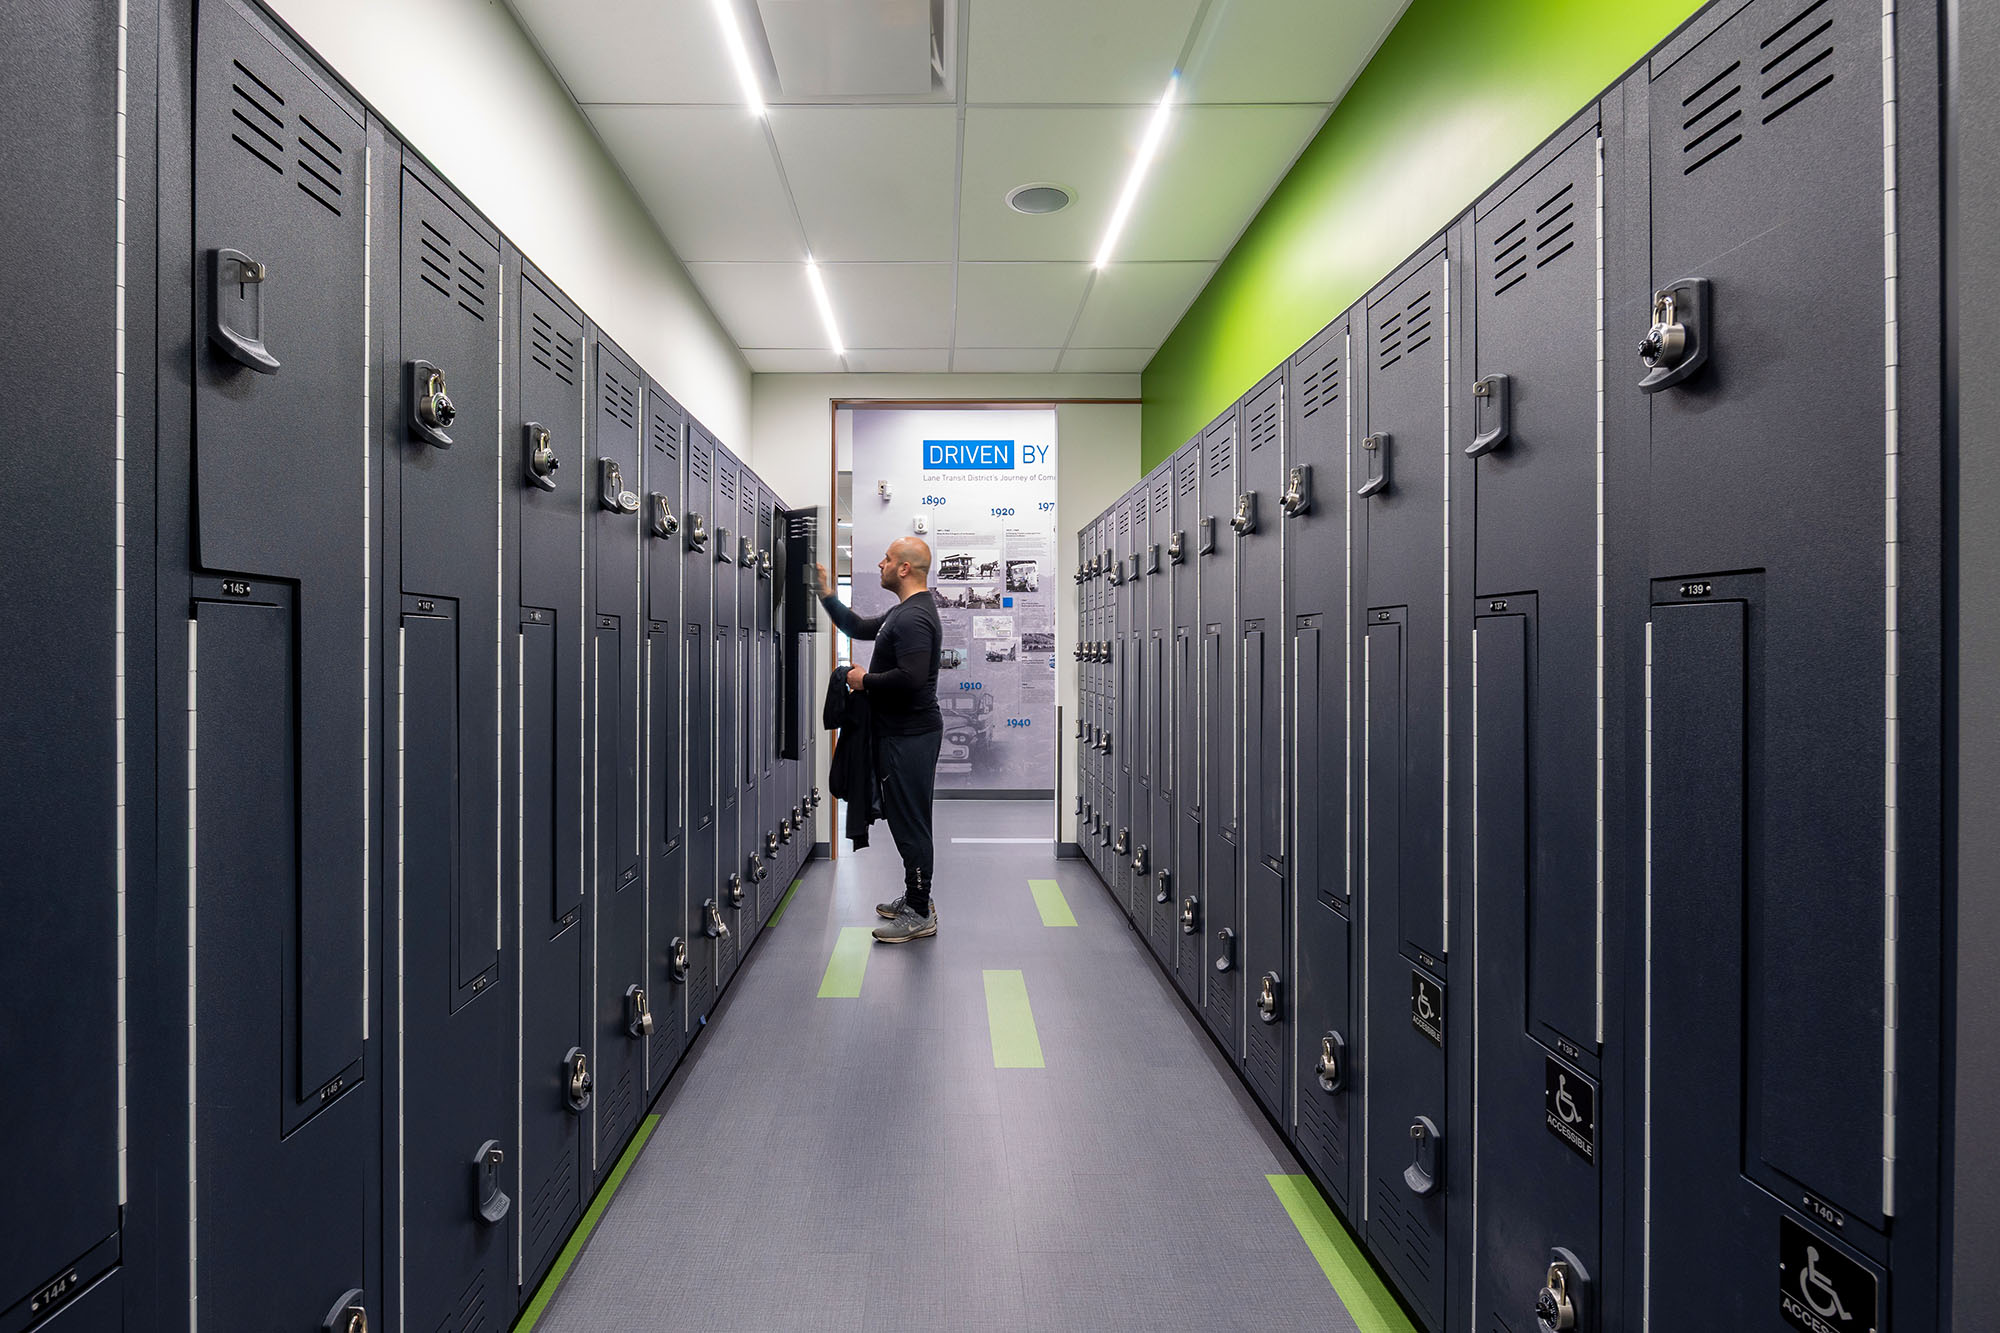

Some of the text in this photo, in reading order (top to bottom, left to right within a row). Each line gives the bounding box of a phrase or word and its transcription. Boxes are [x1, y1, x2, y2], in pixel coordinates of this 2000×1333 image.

[930, 445, 1049, 464] DRIVEN BY
[923, 474, 941, 482] Lane
[942, 474, 966, 482] Transit
[967, 473, 998, 482] District's
[999, 474, 1028, 483] Journey
[921, 495, 946, 506] 1890
[991, 508, 1015, 517] 1920
[229, 582, 245, 594] 145
[1687, 584, 1704, 595] 139
[960, 682, 982, 691] 1910
[1007, 718, 1031, 728] 1940
[1562, 1043, 1574, 1056] 138
[1547, 1114, 1592, 1156] ACCESSIBLE
[1813, 1202, 1834, 1223] 140
[43, 1279, 66, 1304] 144
